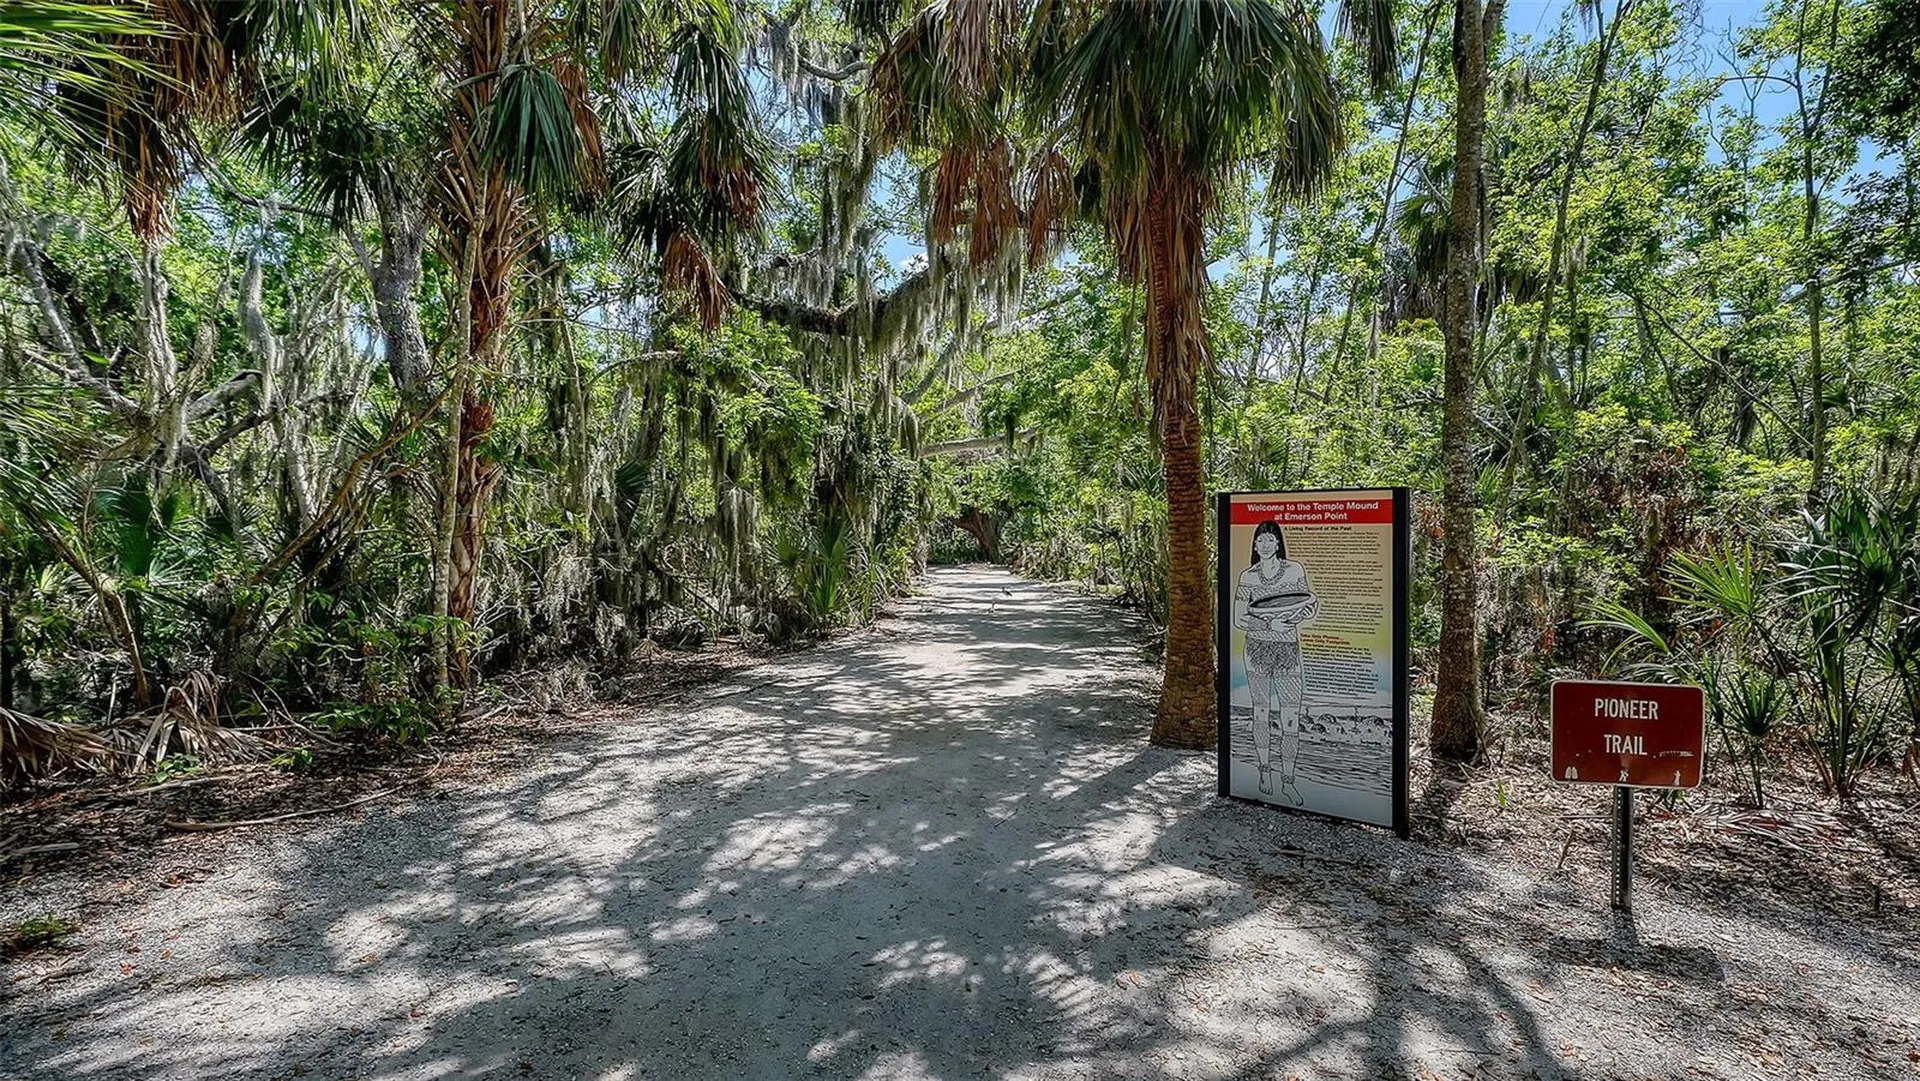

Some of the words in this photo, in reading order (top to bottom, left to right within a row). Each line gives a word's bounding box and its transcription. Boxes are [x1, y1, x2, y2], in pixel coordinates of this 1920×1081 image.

[1247, 504, 1285, 512] Welcome
[1286, 503, 1295, 511] to
[1297, 502, 1311, 511] the
[1312, 502, 1344, 512] Temple
[1346, 501, 1379, 511] Mound
[1274, 513, 1283, 521] at
[1285, 512, 1322, 521] Emerson
[1324, 511, 1348, 520] Point
[1594, 698, 1659, 720] PIONEER
[1604, 734, 1648, 756] TRAIL
